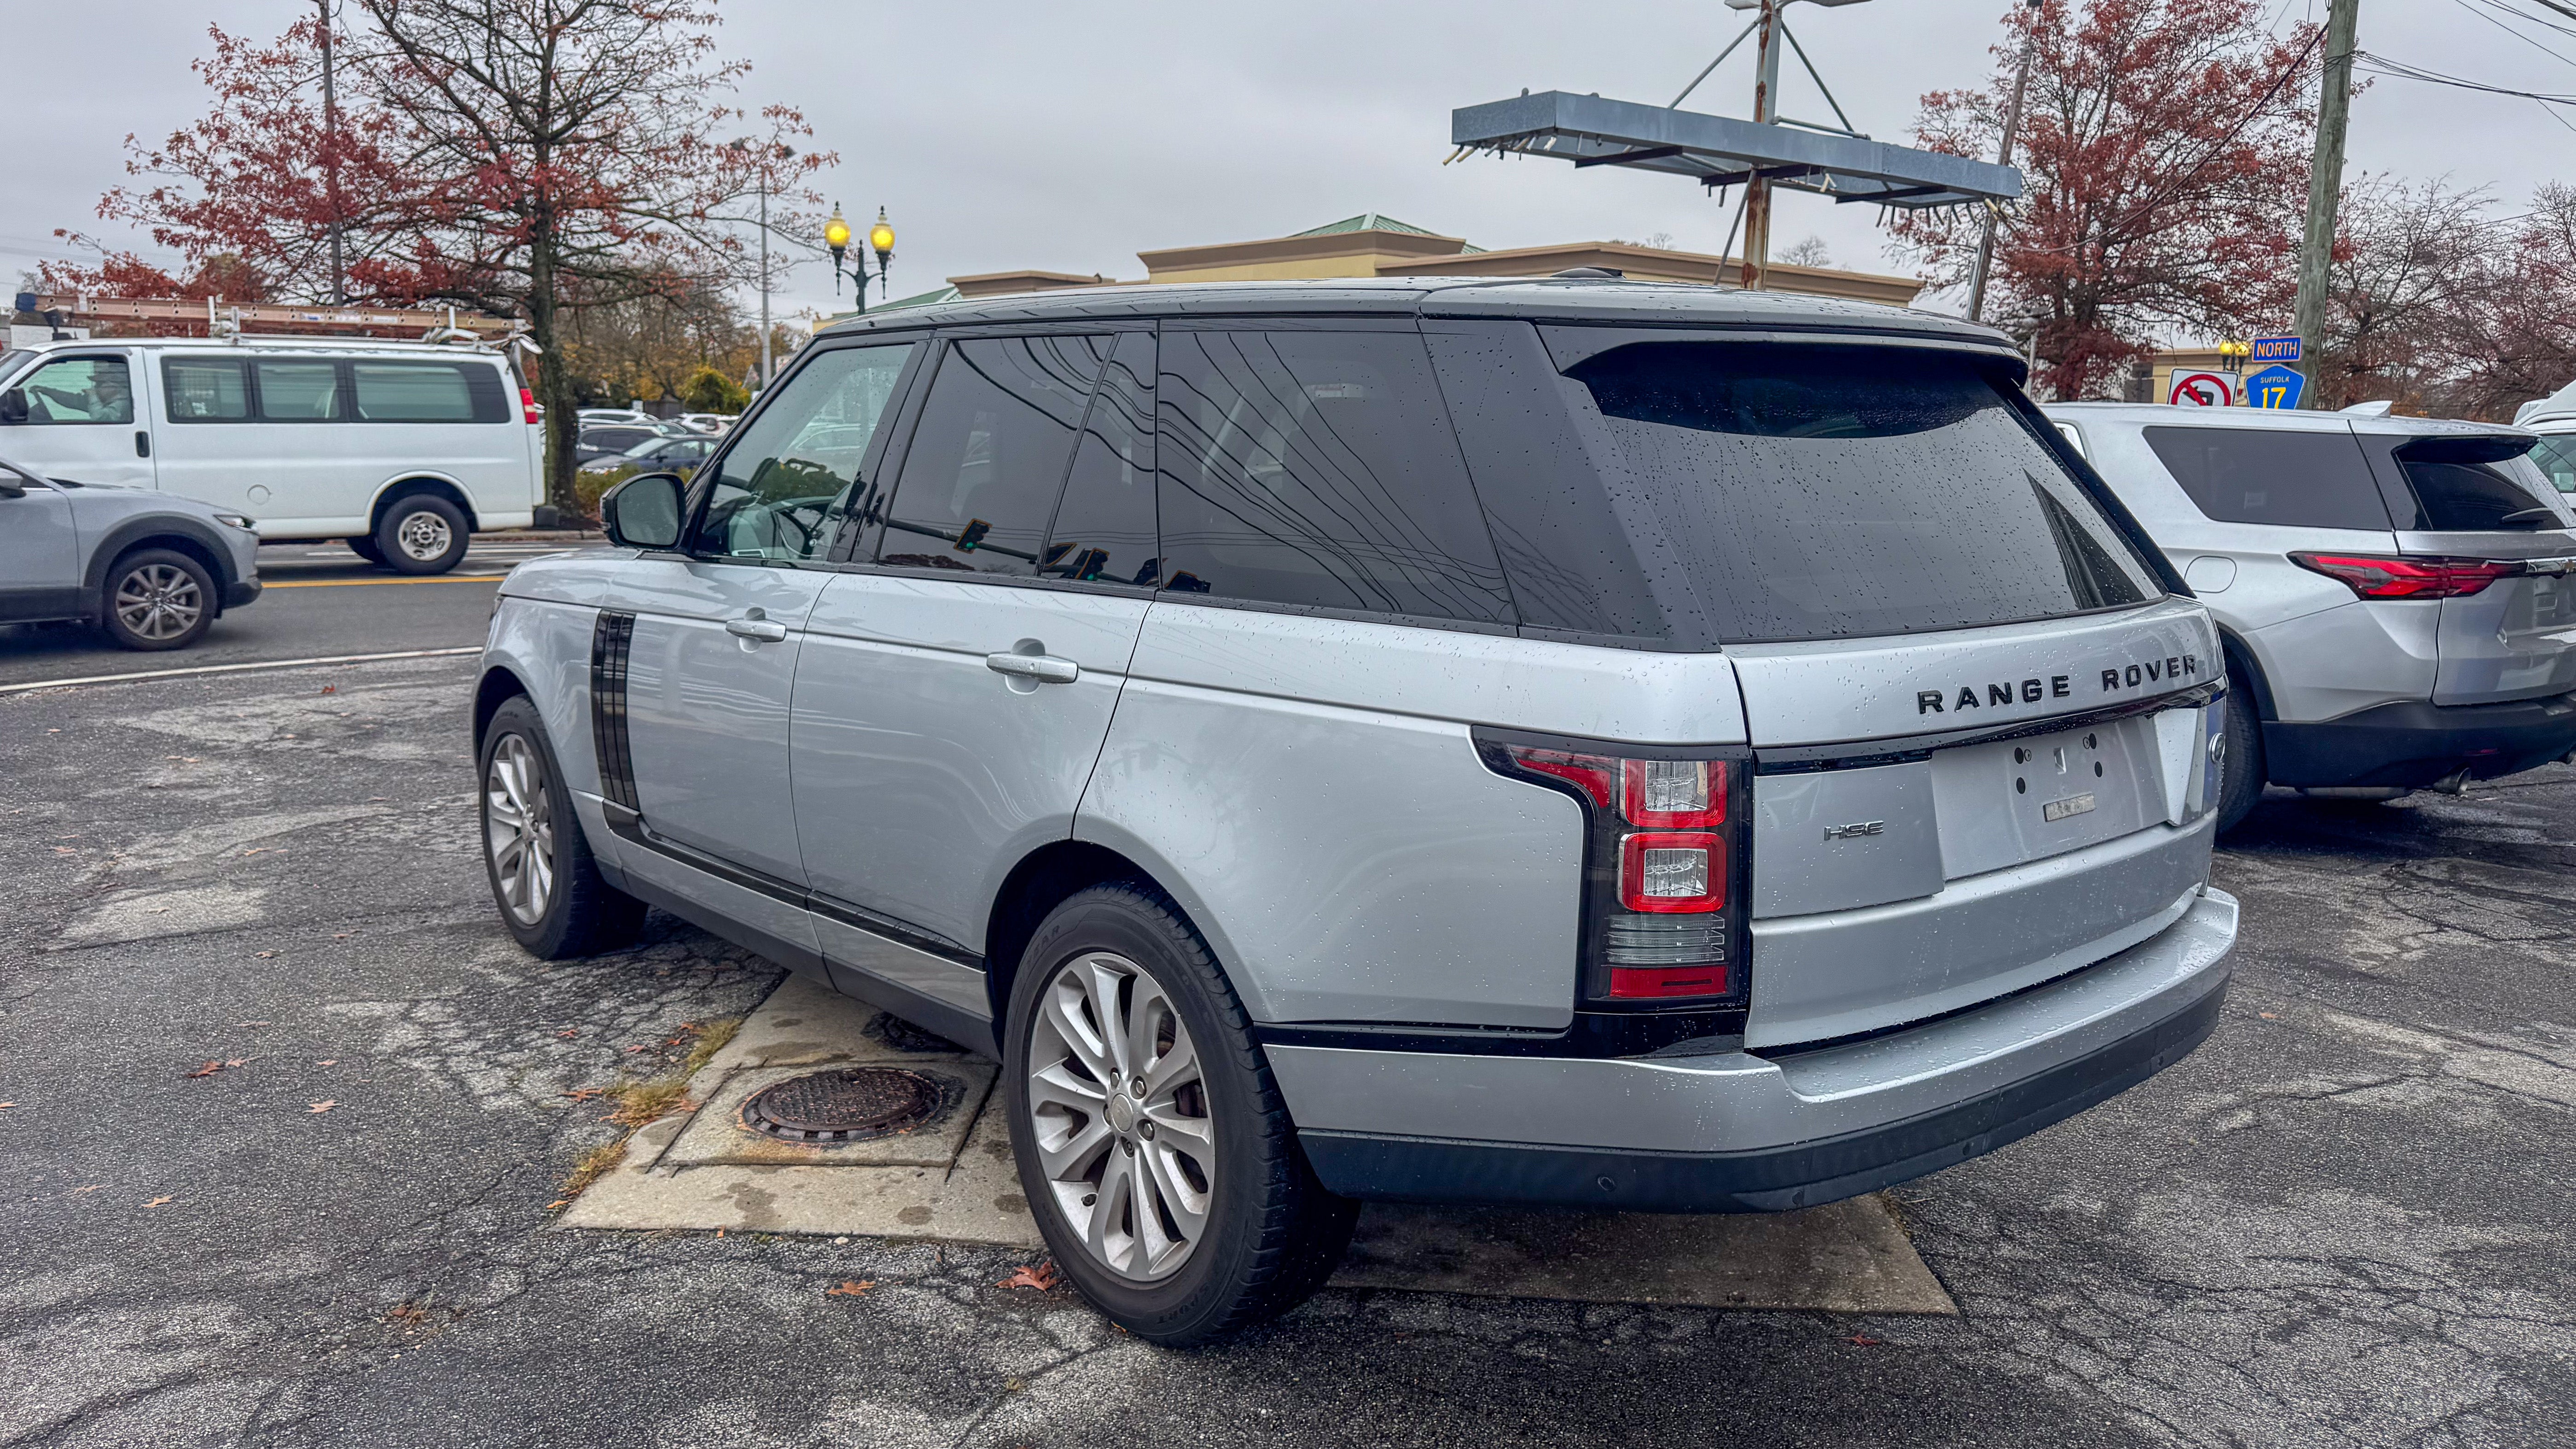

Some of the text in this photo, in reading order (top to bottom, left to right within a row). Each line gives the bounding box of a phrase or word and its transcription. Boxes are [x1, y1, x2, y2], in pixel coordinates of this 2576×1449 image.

[2257, 341, 2297, 357] NORTH
[2260, 376, 2290, 384] SUFFOLK
[2262, 387, 2286, 409] 17
[1917, 654, 2196, 715] RANGE ROVER
[1824, 820, 1884, 841] HSE
